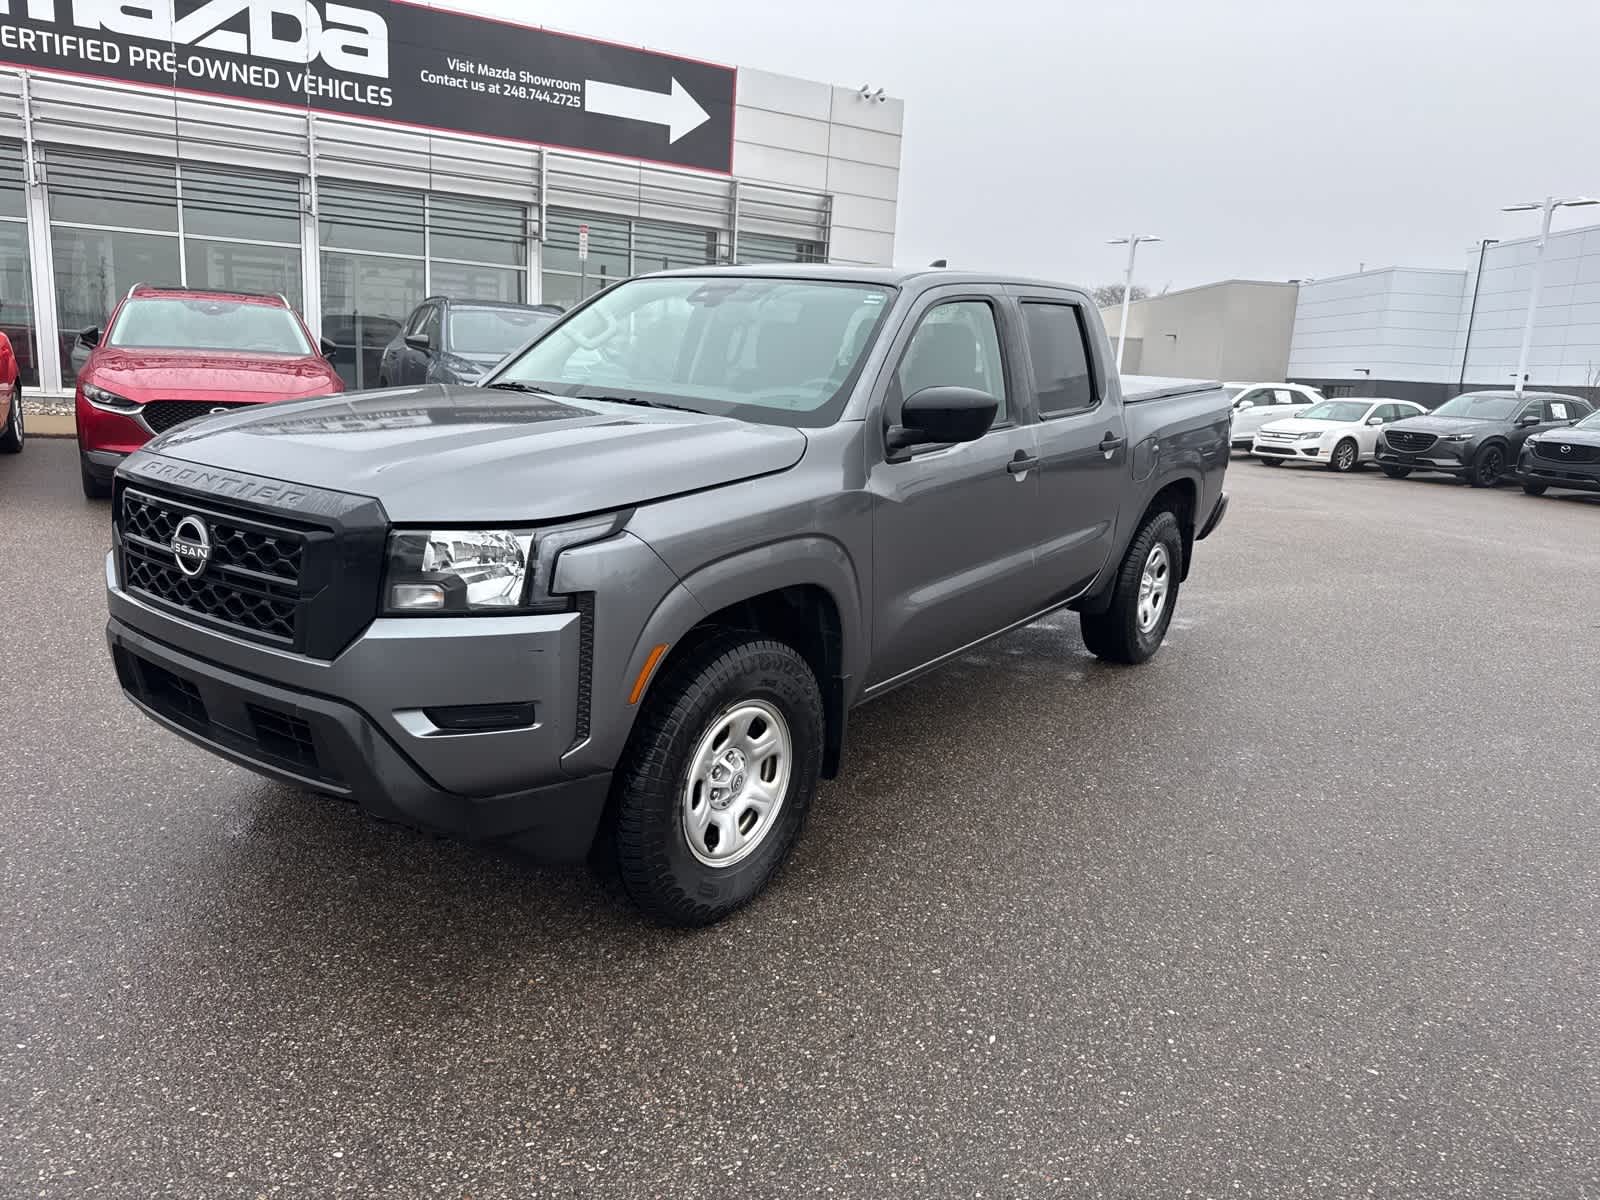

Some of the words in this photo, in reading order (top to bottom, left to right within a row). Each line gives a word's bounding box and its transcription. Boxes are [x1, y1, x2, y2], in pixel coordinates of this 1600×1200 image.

[129, 46, 280, 89] PRE-OWNED
[287, 71, 393, 107] VEHICLES
[420, 70, 468, 89] Contact
[471, 80, 486, 92] us
[488, 82, 501, 95] at
[503, 84, 581, 108] 248.744.2725
[447, 57, 475, 74] Visit
[478, 63, 516, 81] Mazda
[519, 71, 581, 92] Showroom
[142, 461, 306, 508] FRONTIER
